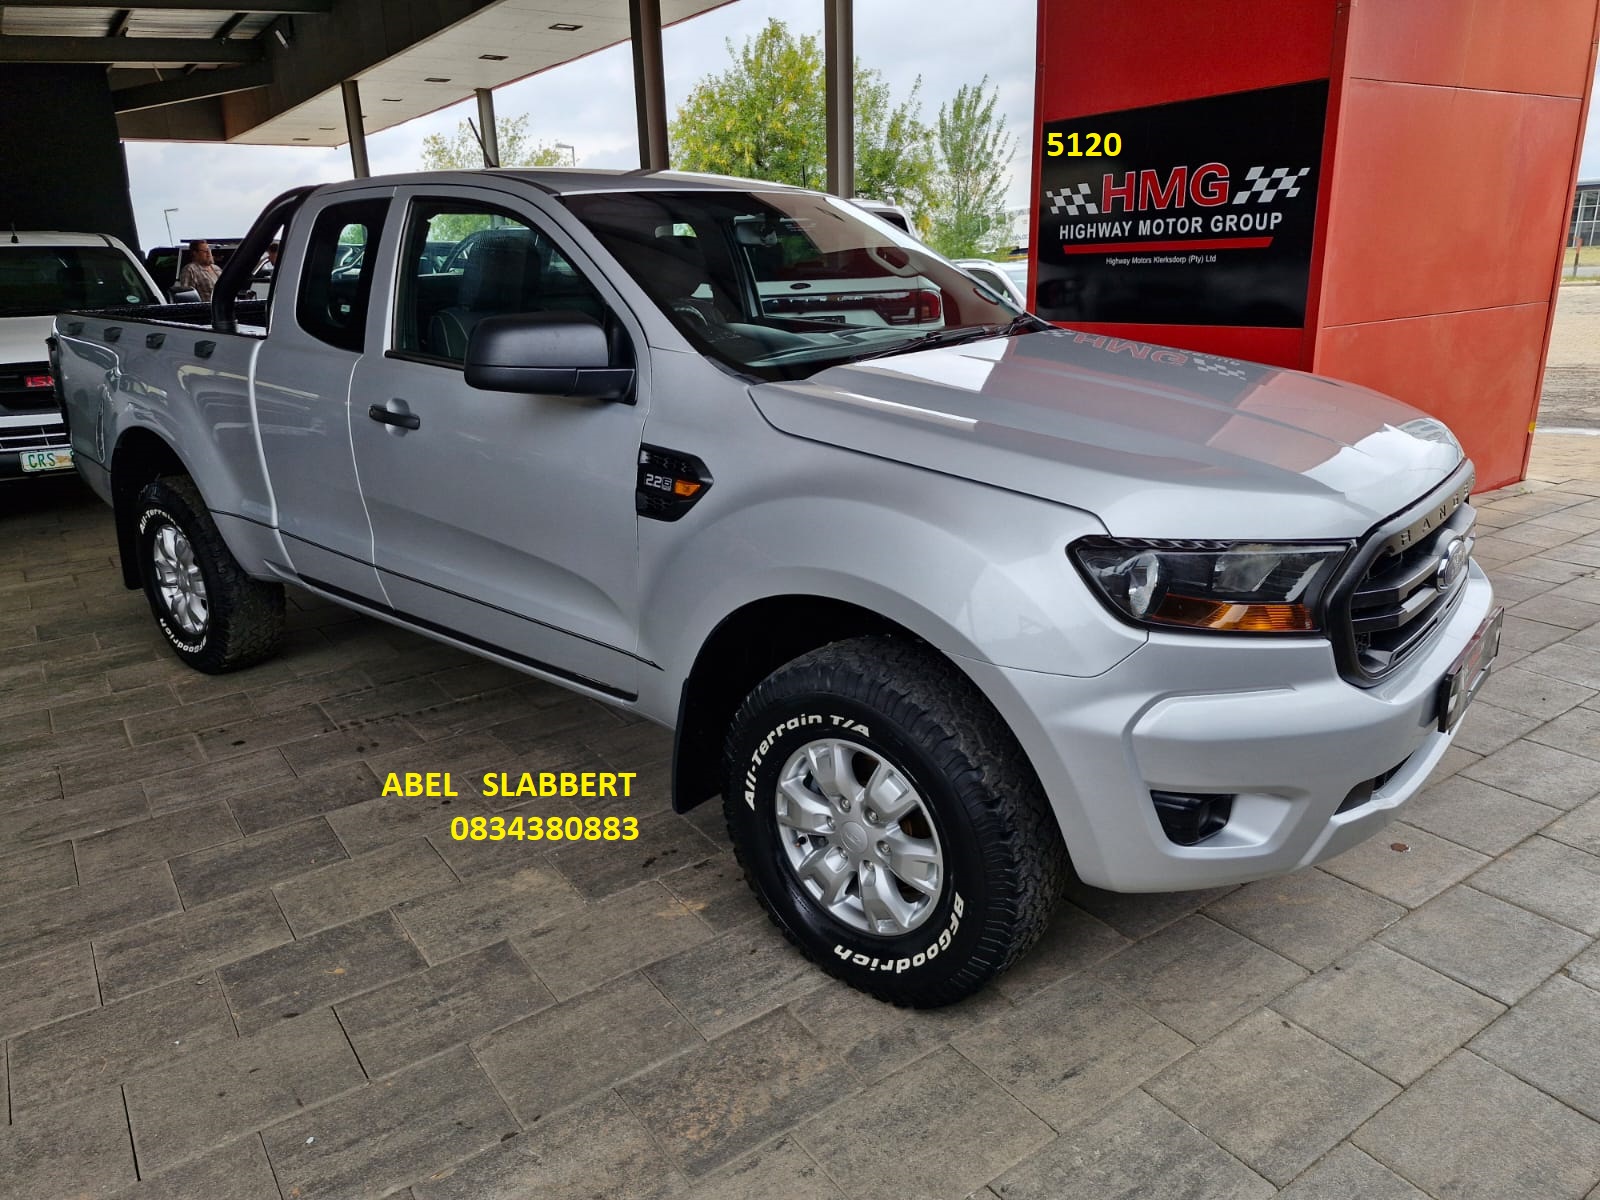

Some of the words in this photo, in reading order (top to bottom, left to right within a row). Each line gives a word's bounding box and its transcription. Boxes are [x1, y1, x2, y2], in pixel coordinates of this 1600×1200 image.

[1101, 162, 1230, 214] HMG
[1059, 220, 1133, 240] HIGHWAY
[1138, 216, 1203, 236] MOTOR
[1210, 212, 1283, 233] GROUP
[1105, 256, 1130, 267] Highway
[1131, 255, 1152, 265] Motors
[1153, 254, 1187, 265] Klerksdorp
[1188, 253, 1204, 265] (Pty)
[1205, 254, 1217, 263] Ltd
[27, 452, 56, 469] CRS
[744, 713, 823, 811] All-Terrain
[829, 714, 870, 738] T/A
[834, 891, 964, 974] BFGoodrich
